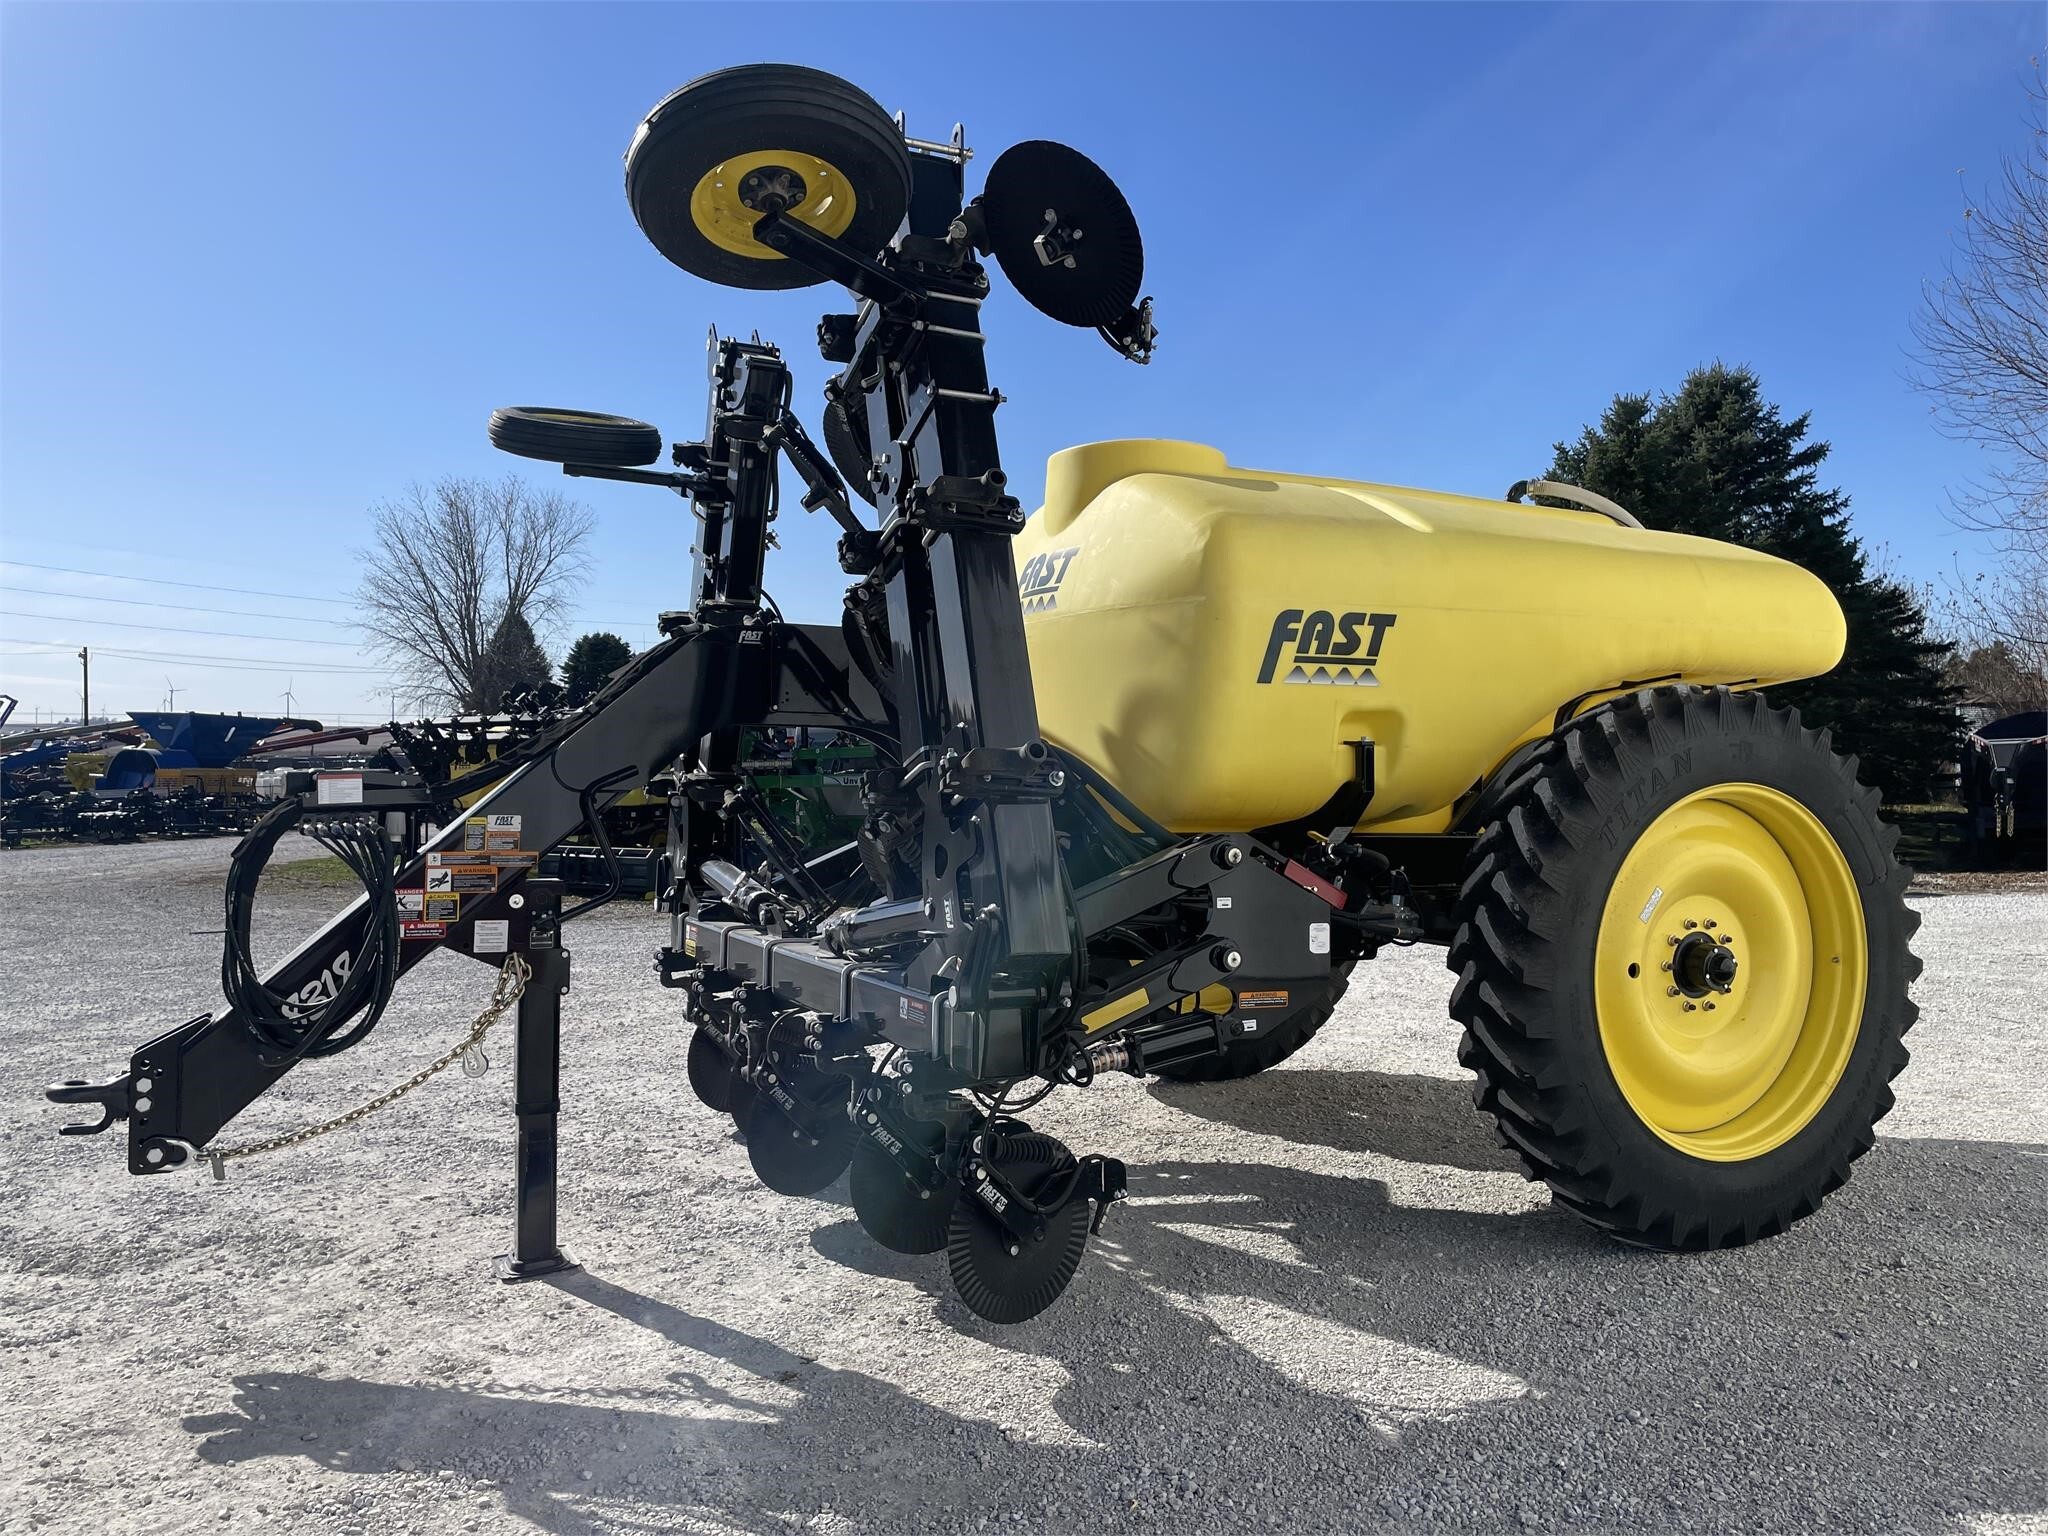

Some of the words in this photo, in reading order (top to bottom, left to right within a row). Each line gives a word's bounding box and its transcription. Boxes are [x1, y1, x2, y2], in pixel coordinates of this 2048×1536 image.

[1019, 547, 1081, 593] FAST
[738, 630, 763, 644] FAST
[1256, 608, 1398, 684] FAST
[1599, 748, 1693, 849] TITAN
[494, 815, 514, 826] FAST
[944, 899, 954, 929] FAST
[870, 1126, 896, 1145] FAST
[977, 1178, 1001, 1202] FAST
